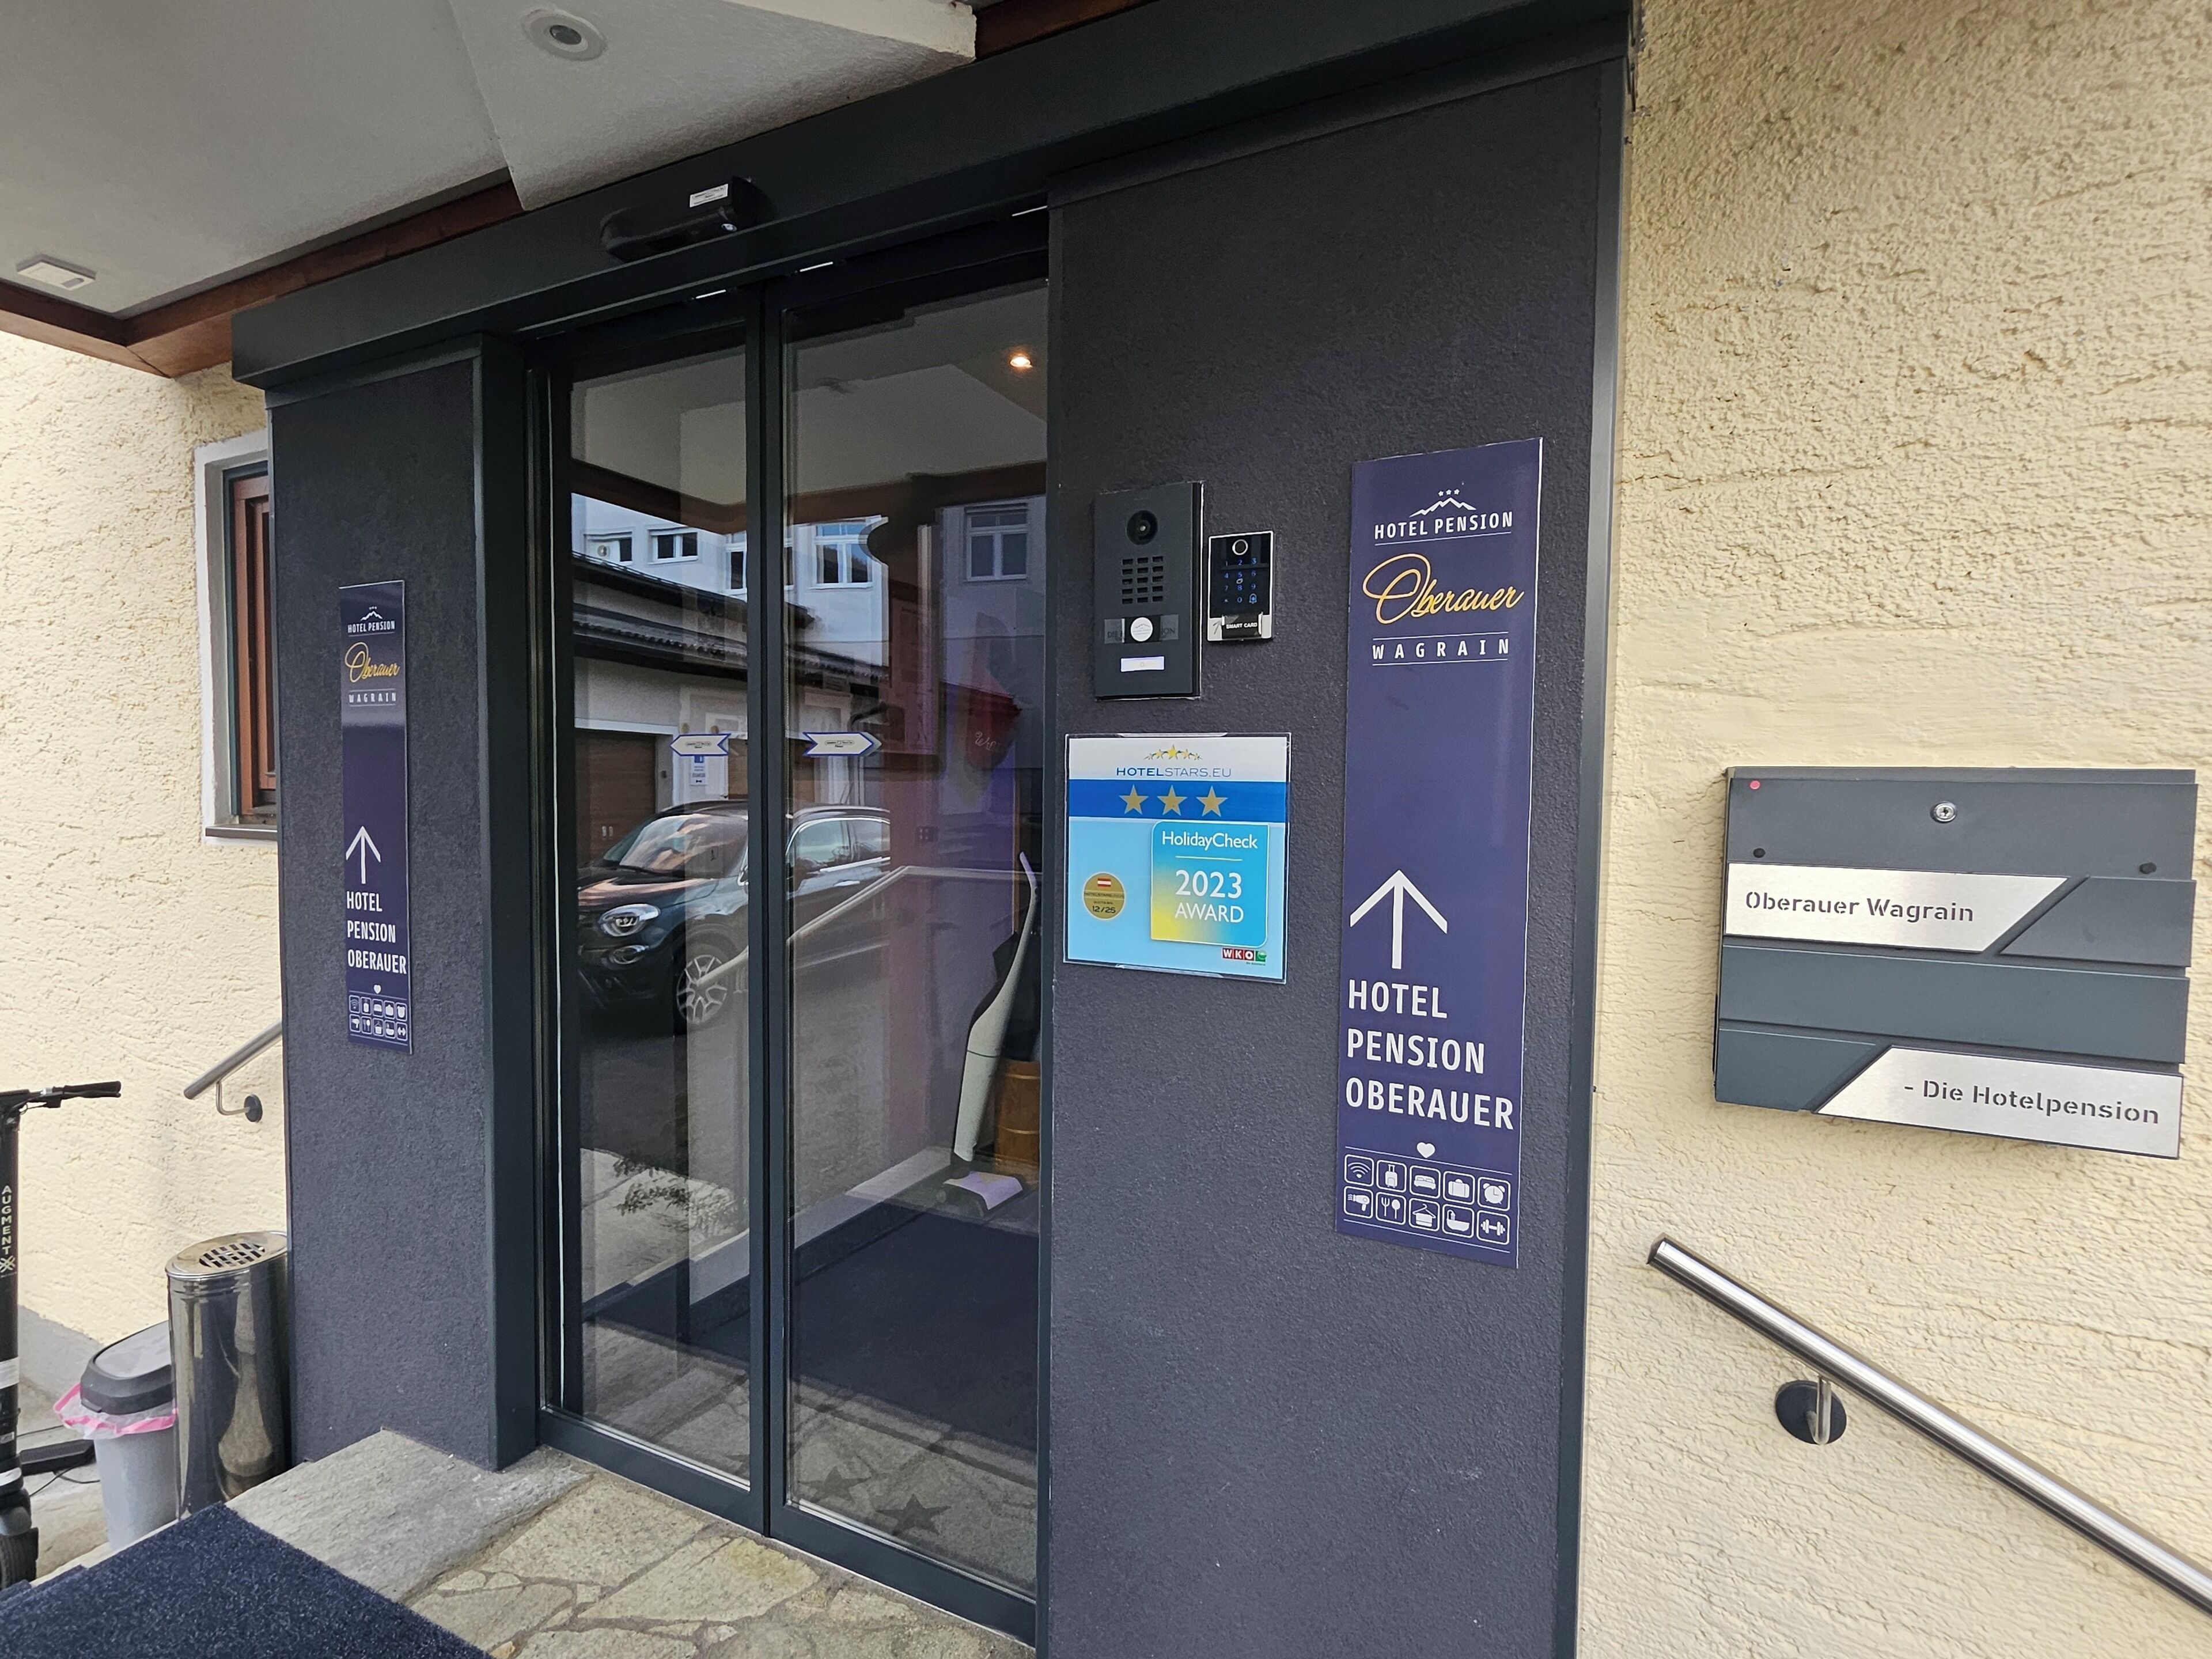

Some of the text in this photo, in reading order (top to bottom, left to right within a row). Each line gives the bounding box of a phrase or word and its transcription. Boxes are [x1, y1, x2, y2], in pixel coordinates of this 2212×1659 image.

[1374, 511, 1513, 540] HOTEL PENSION
[1362, 554, 1525, 624] Oberauer
[347, 620, 395, 634] HOTEL PENSION
[344, 642, 400, 683] Oberauer
[1372, 638, 1509, 660] WAGRAIN
[349, 692, 396, 703] WAGRAIN
[1116, 767, 1232, 778] HOTELSTARS.EU
[1161, 830, 1259, 850] HolidayCheck
[1175, 869, 1242, 899] 2023
[346, 891, 382, 912] HOTEL
[1092, 905, 1116, 914] 12/25
[1174, 902, 1244, 923] AWARD
[1746, 891, 1974, 923] Oberauer Wagrain
[347, 920, 396, 944] PENSION
[347, 949, 407, 975] OBERAUER
[1349, 979, 1448, 1019] HOTEL
[1347, 1028, 1484, 1074] PENSION
[1346, 1077, 1514, 1130] OBERAUER
[1923, 1080, 1964, 1101] Die
[1972, 1085, 2159, 1124] Hotelpension
[1, 1185, 13, 1255] AUGMENT
